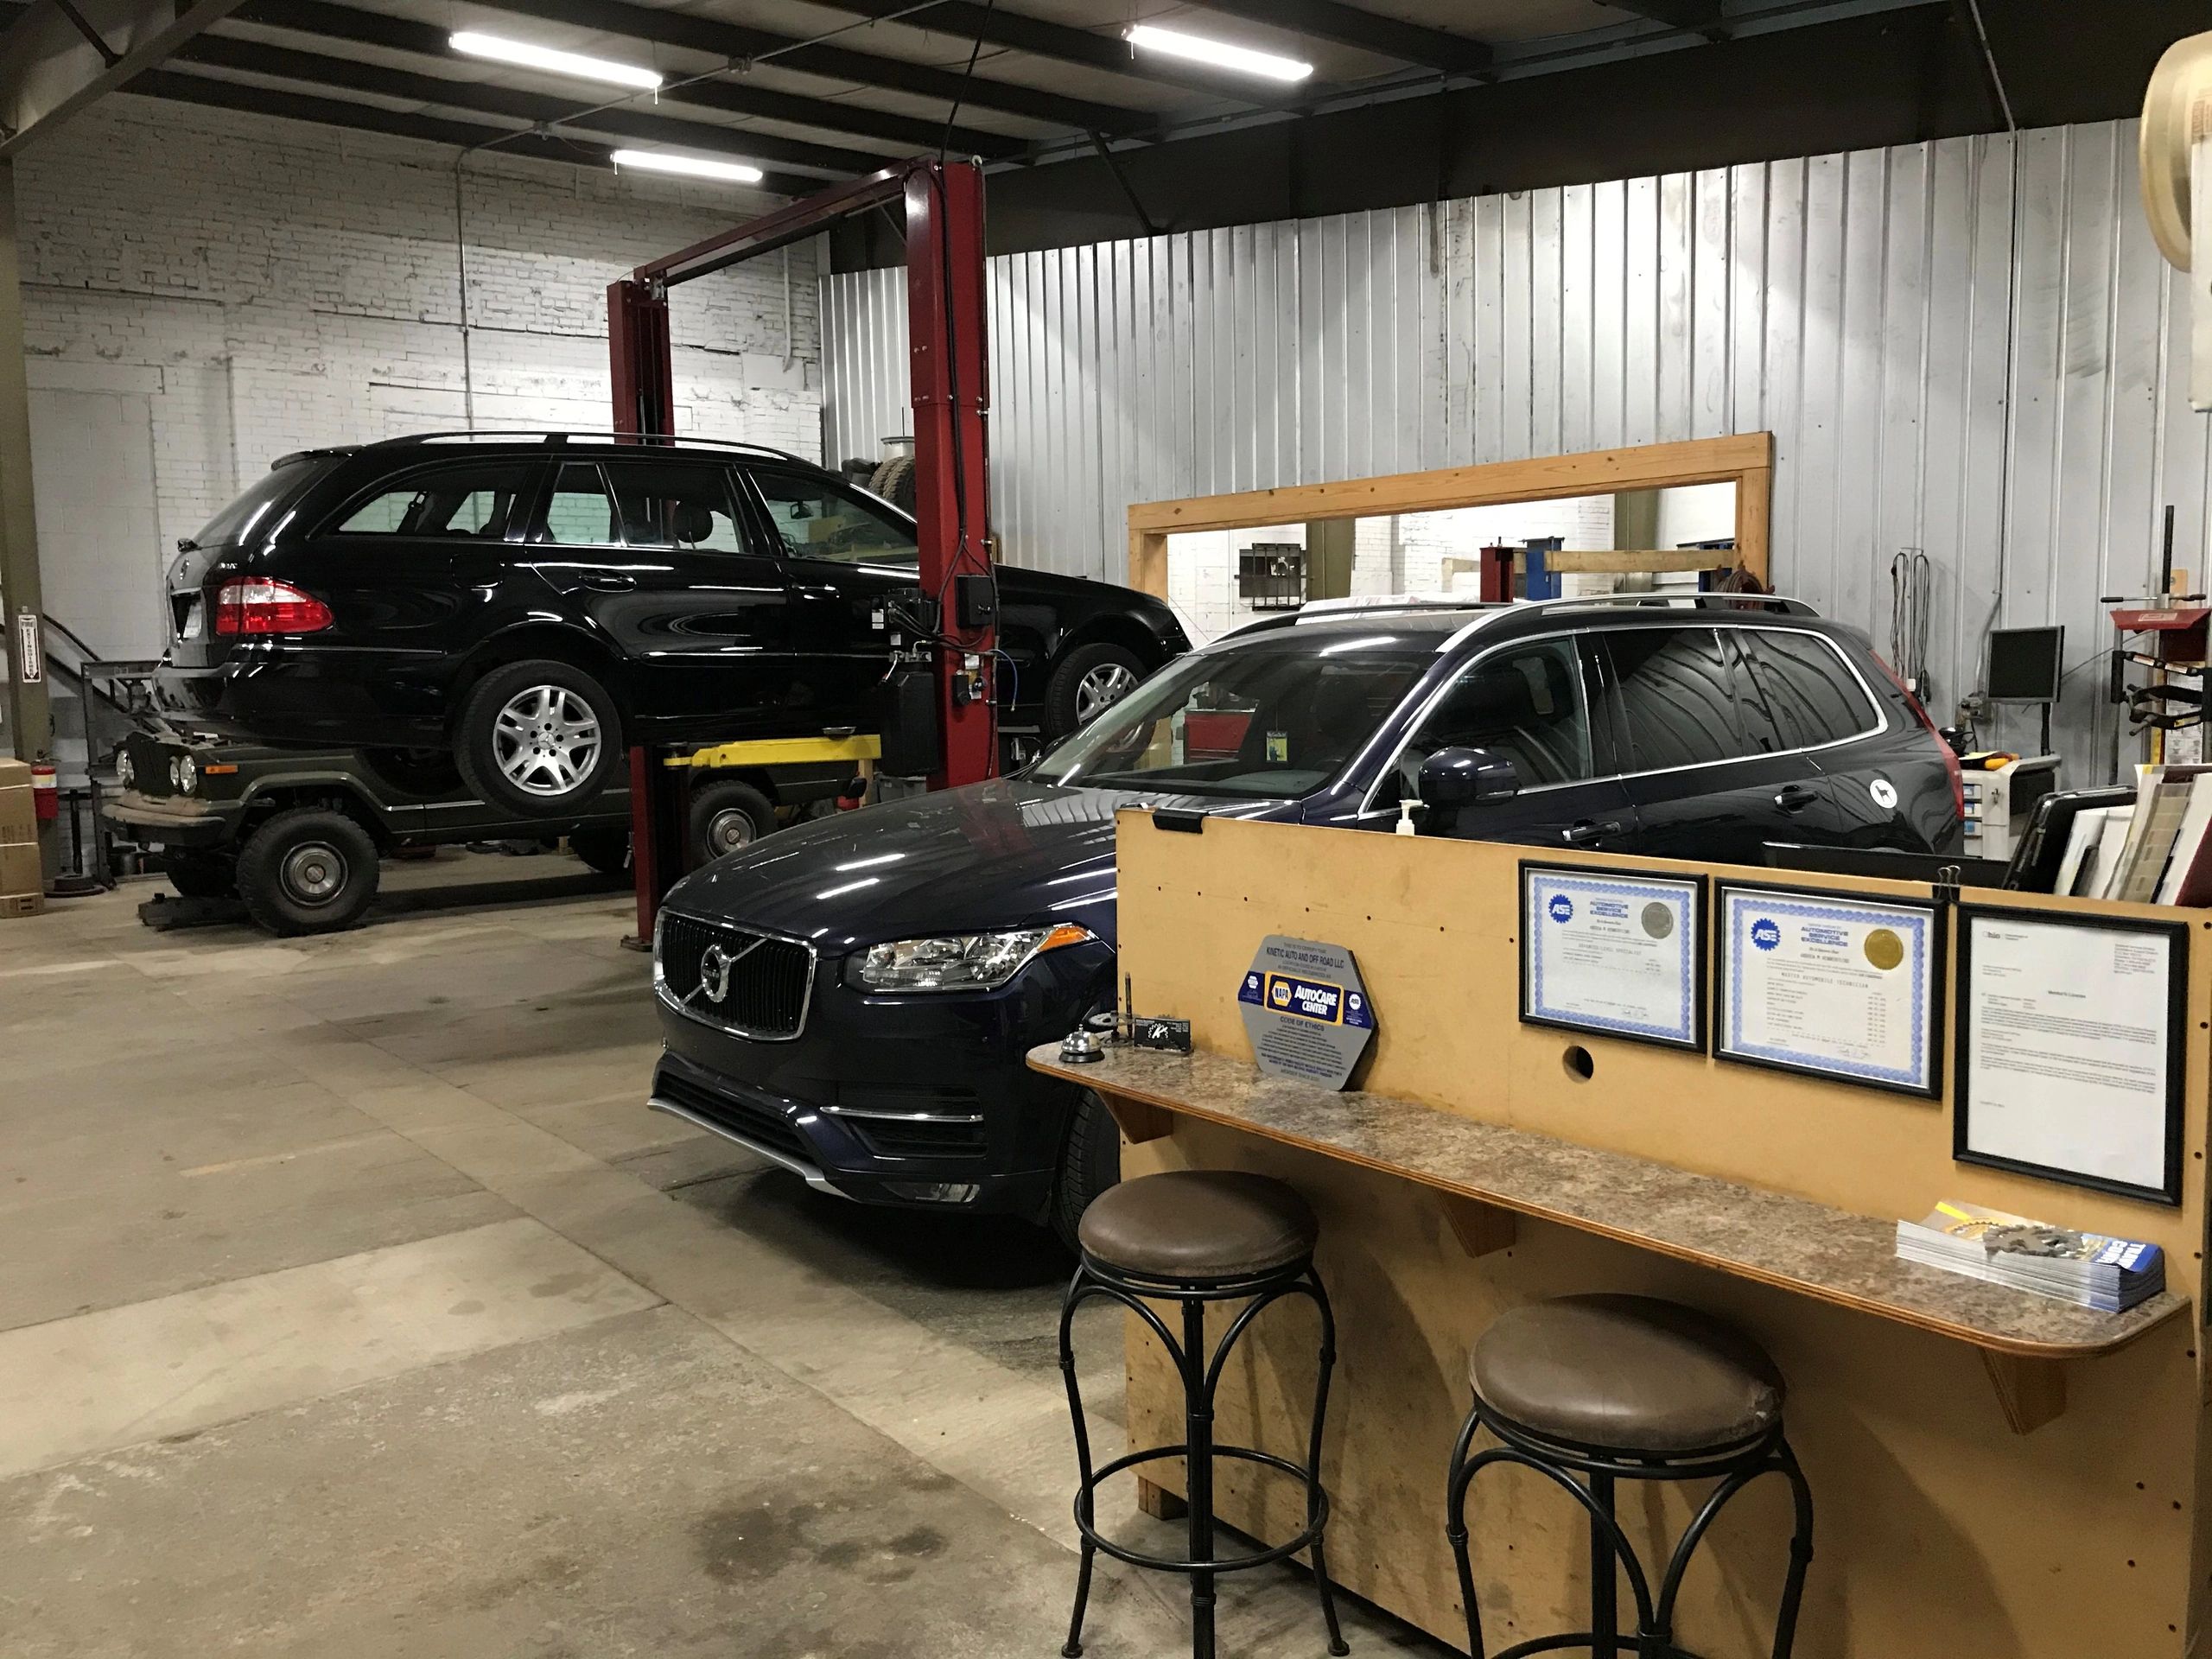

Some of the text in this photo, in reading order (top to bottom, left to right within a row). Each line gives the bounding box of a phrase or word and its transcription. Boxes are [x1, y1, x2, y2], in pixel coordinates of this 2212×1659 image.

[1552, 903, 1570, 915] ASE
[1590, 900, 1629, 910] AUTOMOTIVE
[1590, 910, 1629, 918] EXCELLENCE
[1755, 928, 1777, 942] ASE
[1801, 926, 1848, 937] AUTOMOTIVE
[1801, 937, 1848, 947] EXCELLENCE
[1266, 946, 1284, 958] KINETIC
[1285, 950, 1298, 960] AUTO
[1298, 952, 1309, 963] AND
[1309, 954, 1319, 964] OFF
[1319, 956, 1334, 967] ROAD
[1334, 958, 1344, 969] LLC
[1274, 987, 1289, 1000] NAPA
[1301, 1001, 1328, 1015] CENTER
[1280, 1016, 1295, 1025] CODE
[1305, 1020, 1325, 1032] ETHICS
